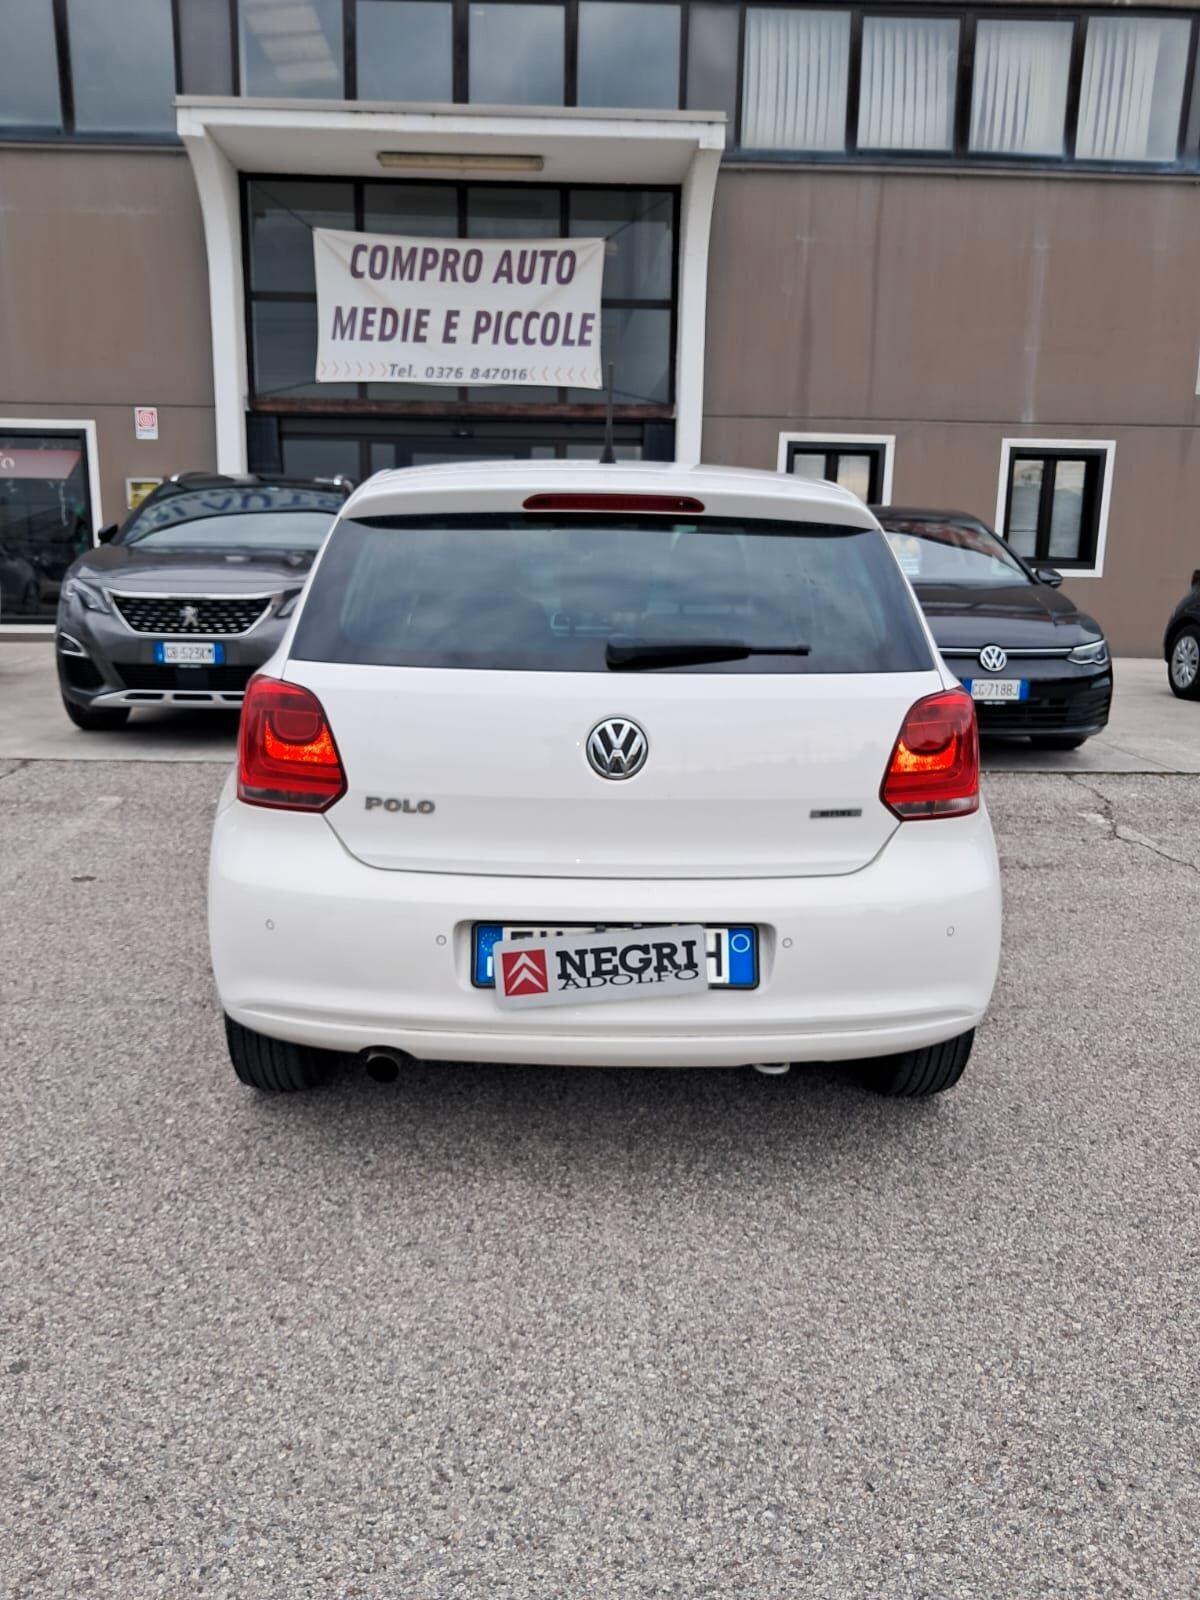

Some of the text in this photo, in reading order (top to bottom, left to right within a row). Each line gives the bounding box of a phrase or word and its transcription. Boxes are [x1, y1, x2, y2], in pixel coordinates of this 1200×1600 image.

[350, 244, 577, 285] COMPRO AUTO
[331, 306, 596, 347] MEDIE E PICCOLE
[390, 364, 528, 381] Tel. 0376 847016
[980, 645, 1007, 671] VW
[587, 717, 648, 780] VW
[365, 796, 436, 815] POLO
[556, 940, 698, 979] NEGRI
[558, 969, 699, 991] ADOLFO
